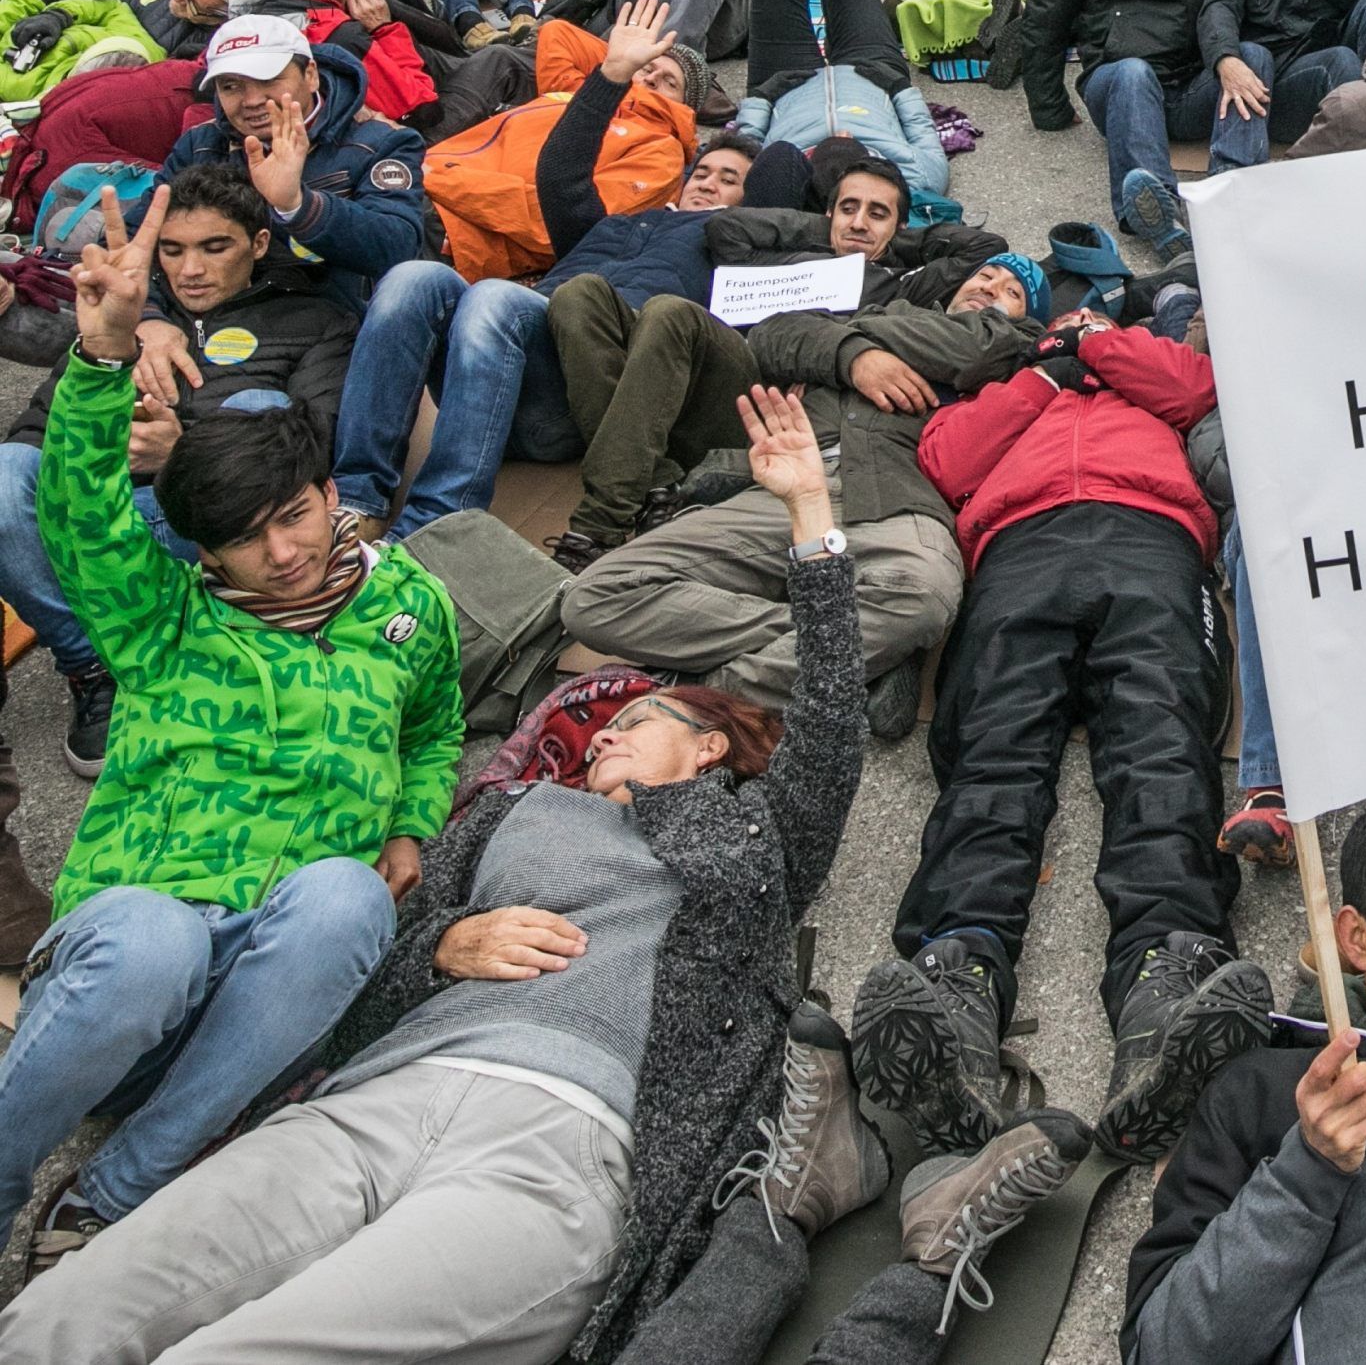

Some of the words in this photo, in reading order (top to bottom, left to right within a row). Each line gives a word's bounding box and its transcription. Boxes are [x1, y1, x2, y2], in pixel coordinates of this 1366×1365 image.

[725, 272, 814, 288] Frauenpower
[723, 292, 755, 303] statt
[758, 285, 810, 299] muffige
